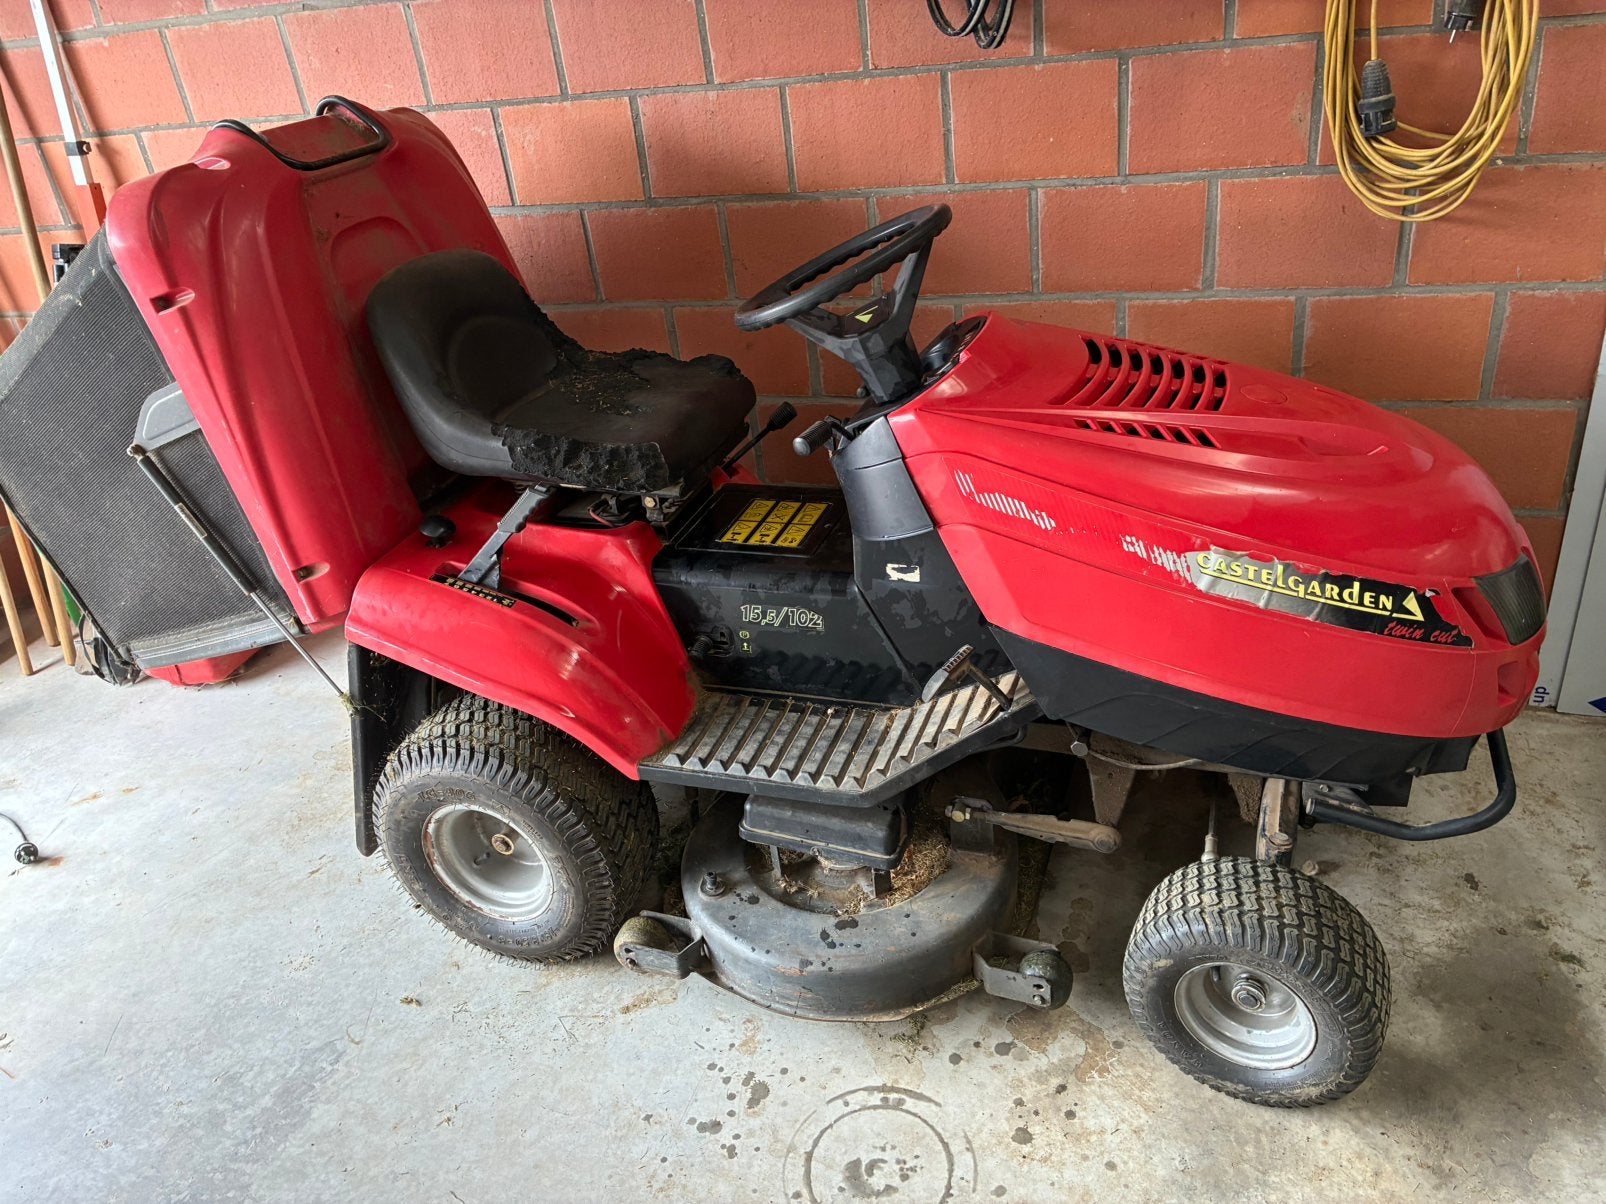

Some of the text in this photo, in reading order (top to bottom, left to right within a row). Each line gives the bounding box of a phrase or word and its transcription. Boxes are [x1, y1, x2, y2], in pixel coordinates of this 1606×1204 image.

[740, 604, 823, 628] 15,5/102
[1384, 620, 1458, 644] twin cut
